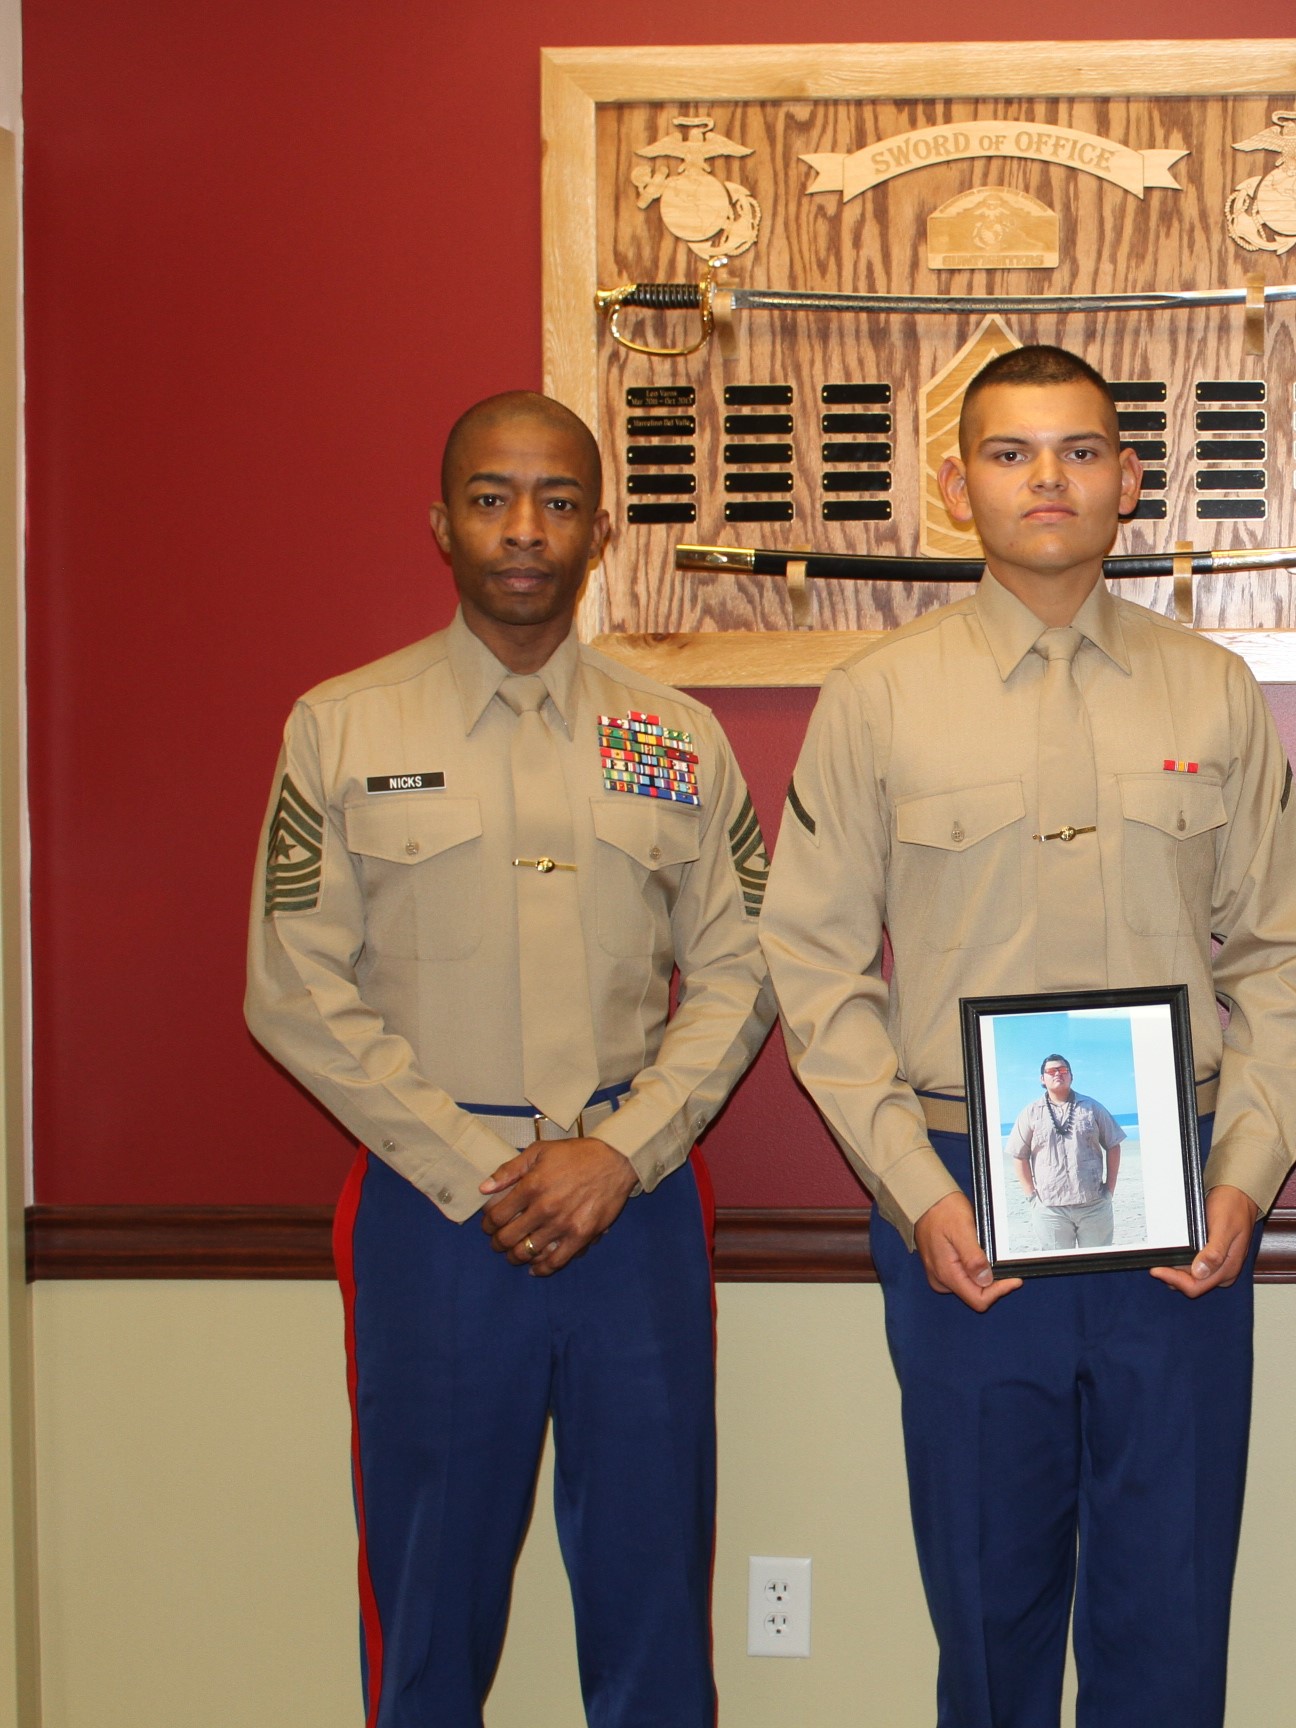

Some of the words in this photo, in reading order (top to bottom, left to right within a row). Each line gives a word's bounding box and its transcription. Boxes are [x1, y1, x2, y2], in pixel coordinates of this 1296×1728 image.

[871, 131, 971, 175] SWORD
[978, 135, 1007, 152] OF
[1014, 131, 1117, 172] OFFICE
[389, 775, 422, 789] NICKS
